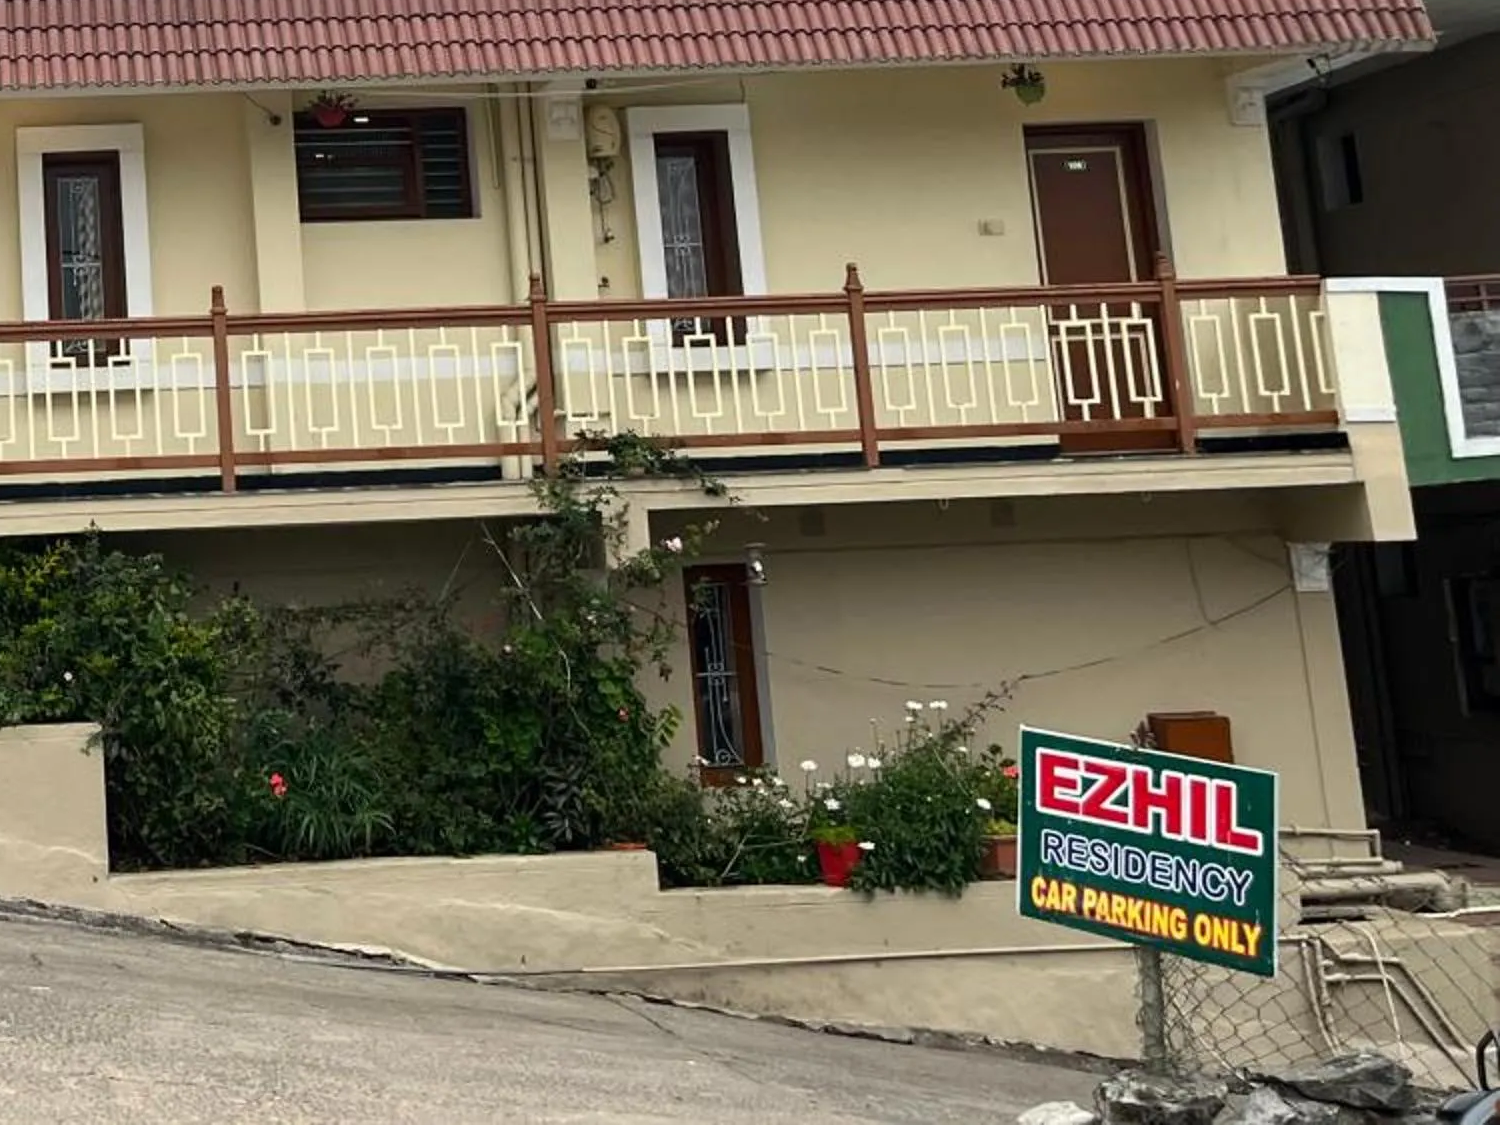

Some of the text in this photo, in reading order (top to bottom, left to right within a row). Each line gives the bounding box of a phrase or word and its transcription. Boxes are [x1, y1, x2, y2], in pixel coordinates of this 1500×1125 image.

[1037, 748, 1263, 856] EZHIL
[1041, 830, 1252, 905] RESIDENCY
[1031, 876, 1261, 956] CAR PARKING ONLY
